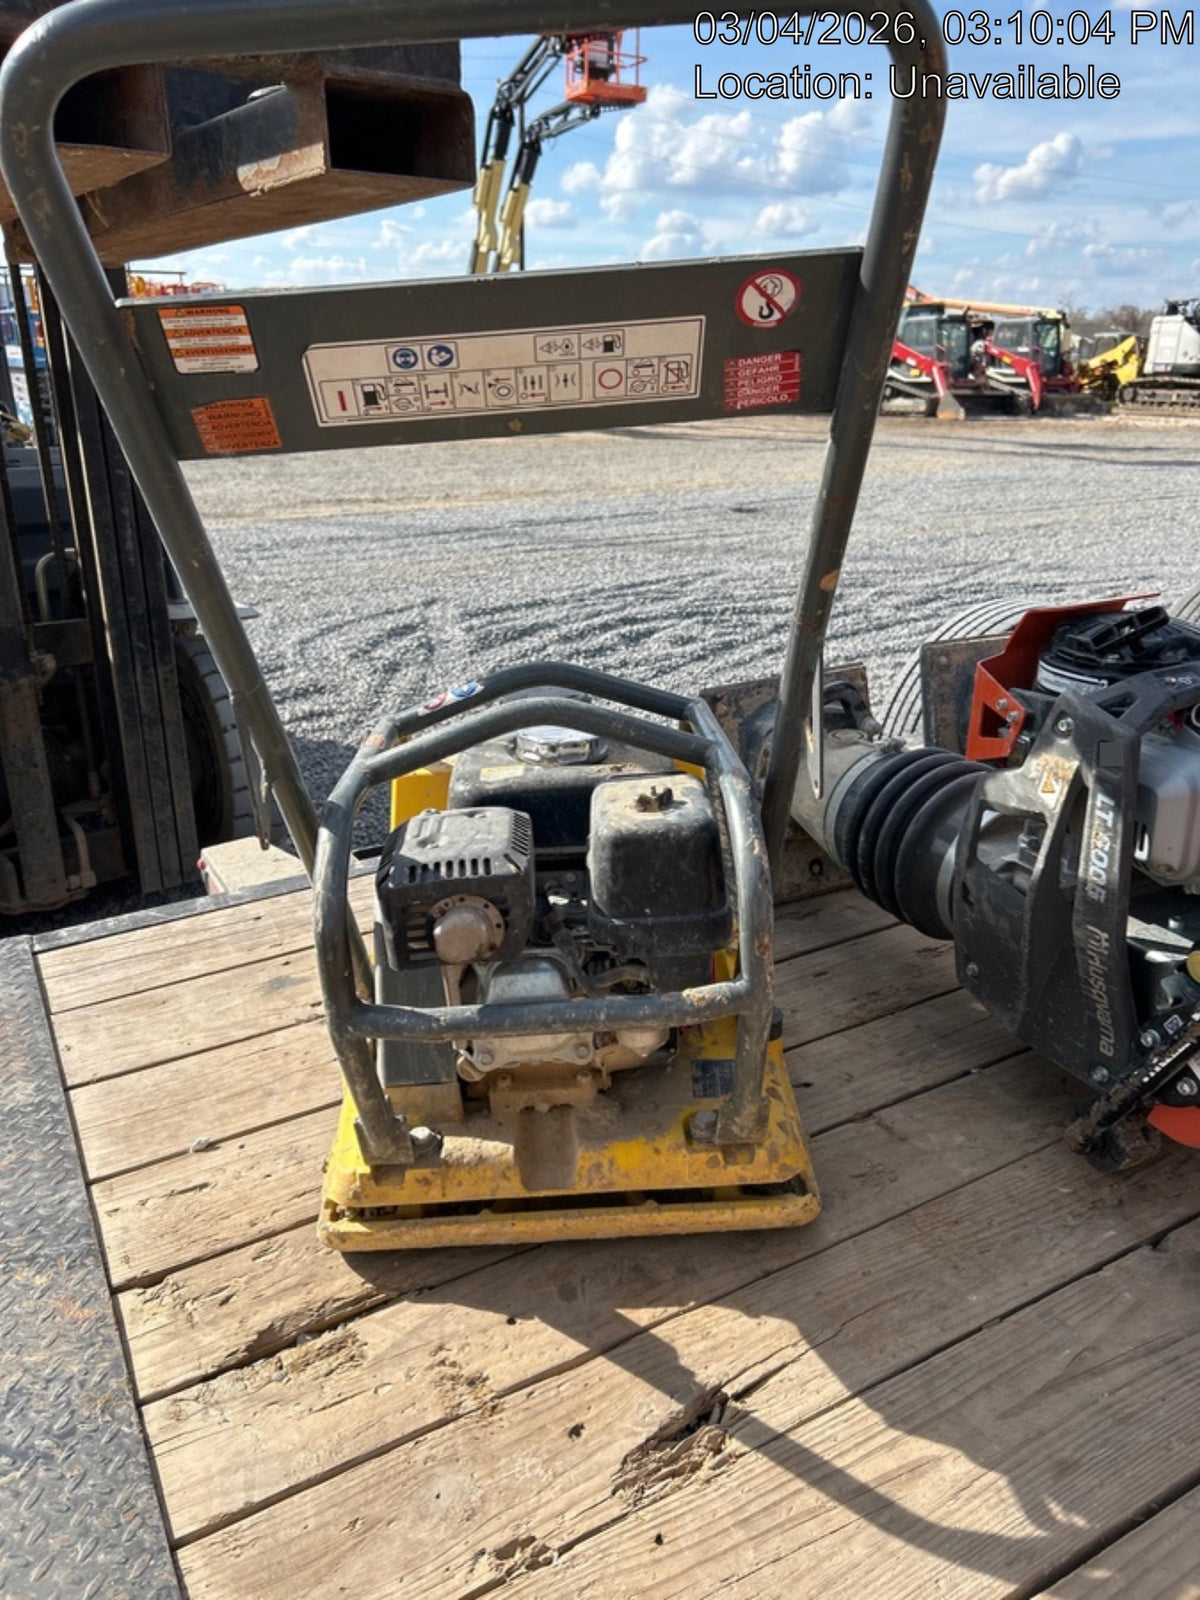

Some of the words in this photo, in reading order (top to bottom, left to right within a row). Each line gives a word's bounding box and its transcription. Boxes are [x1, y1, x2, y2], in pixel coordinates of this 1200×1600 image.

[184, 327, 243, 337] ADVERTENCIA
[738, 353, 782, 367] DANGER
[738, 365, 779, 377] GEFAHR
[738, 375, 783, 387] PELIGRO
[737, 385, 781, 398] DANGER
[1095, 793, 1116, 828] LT
